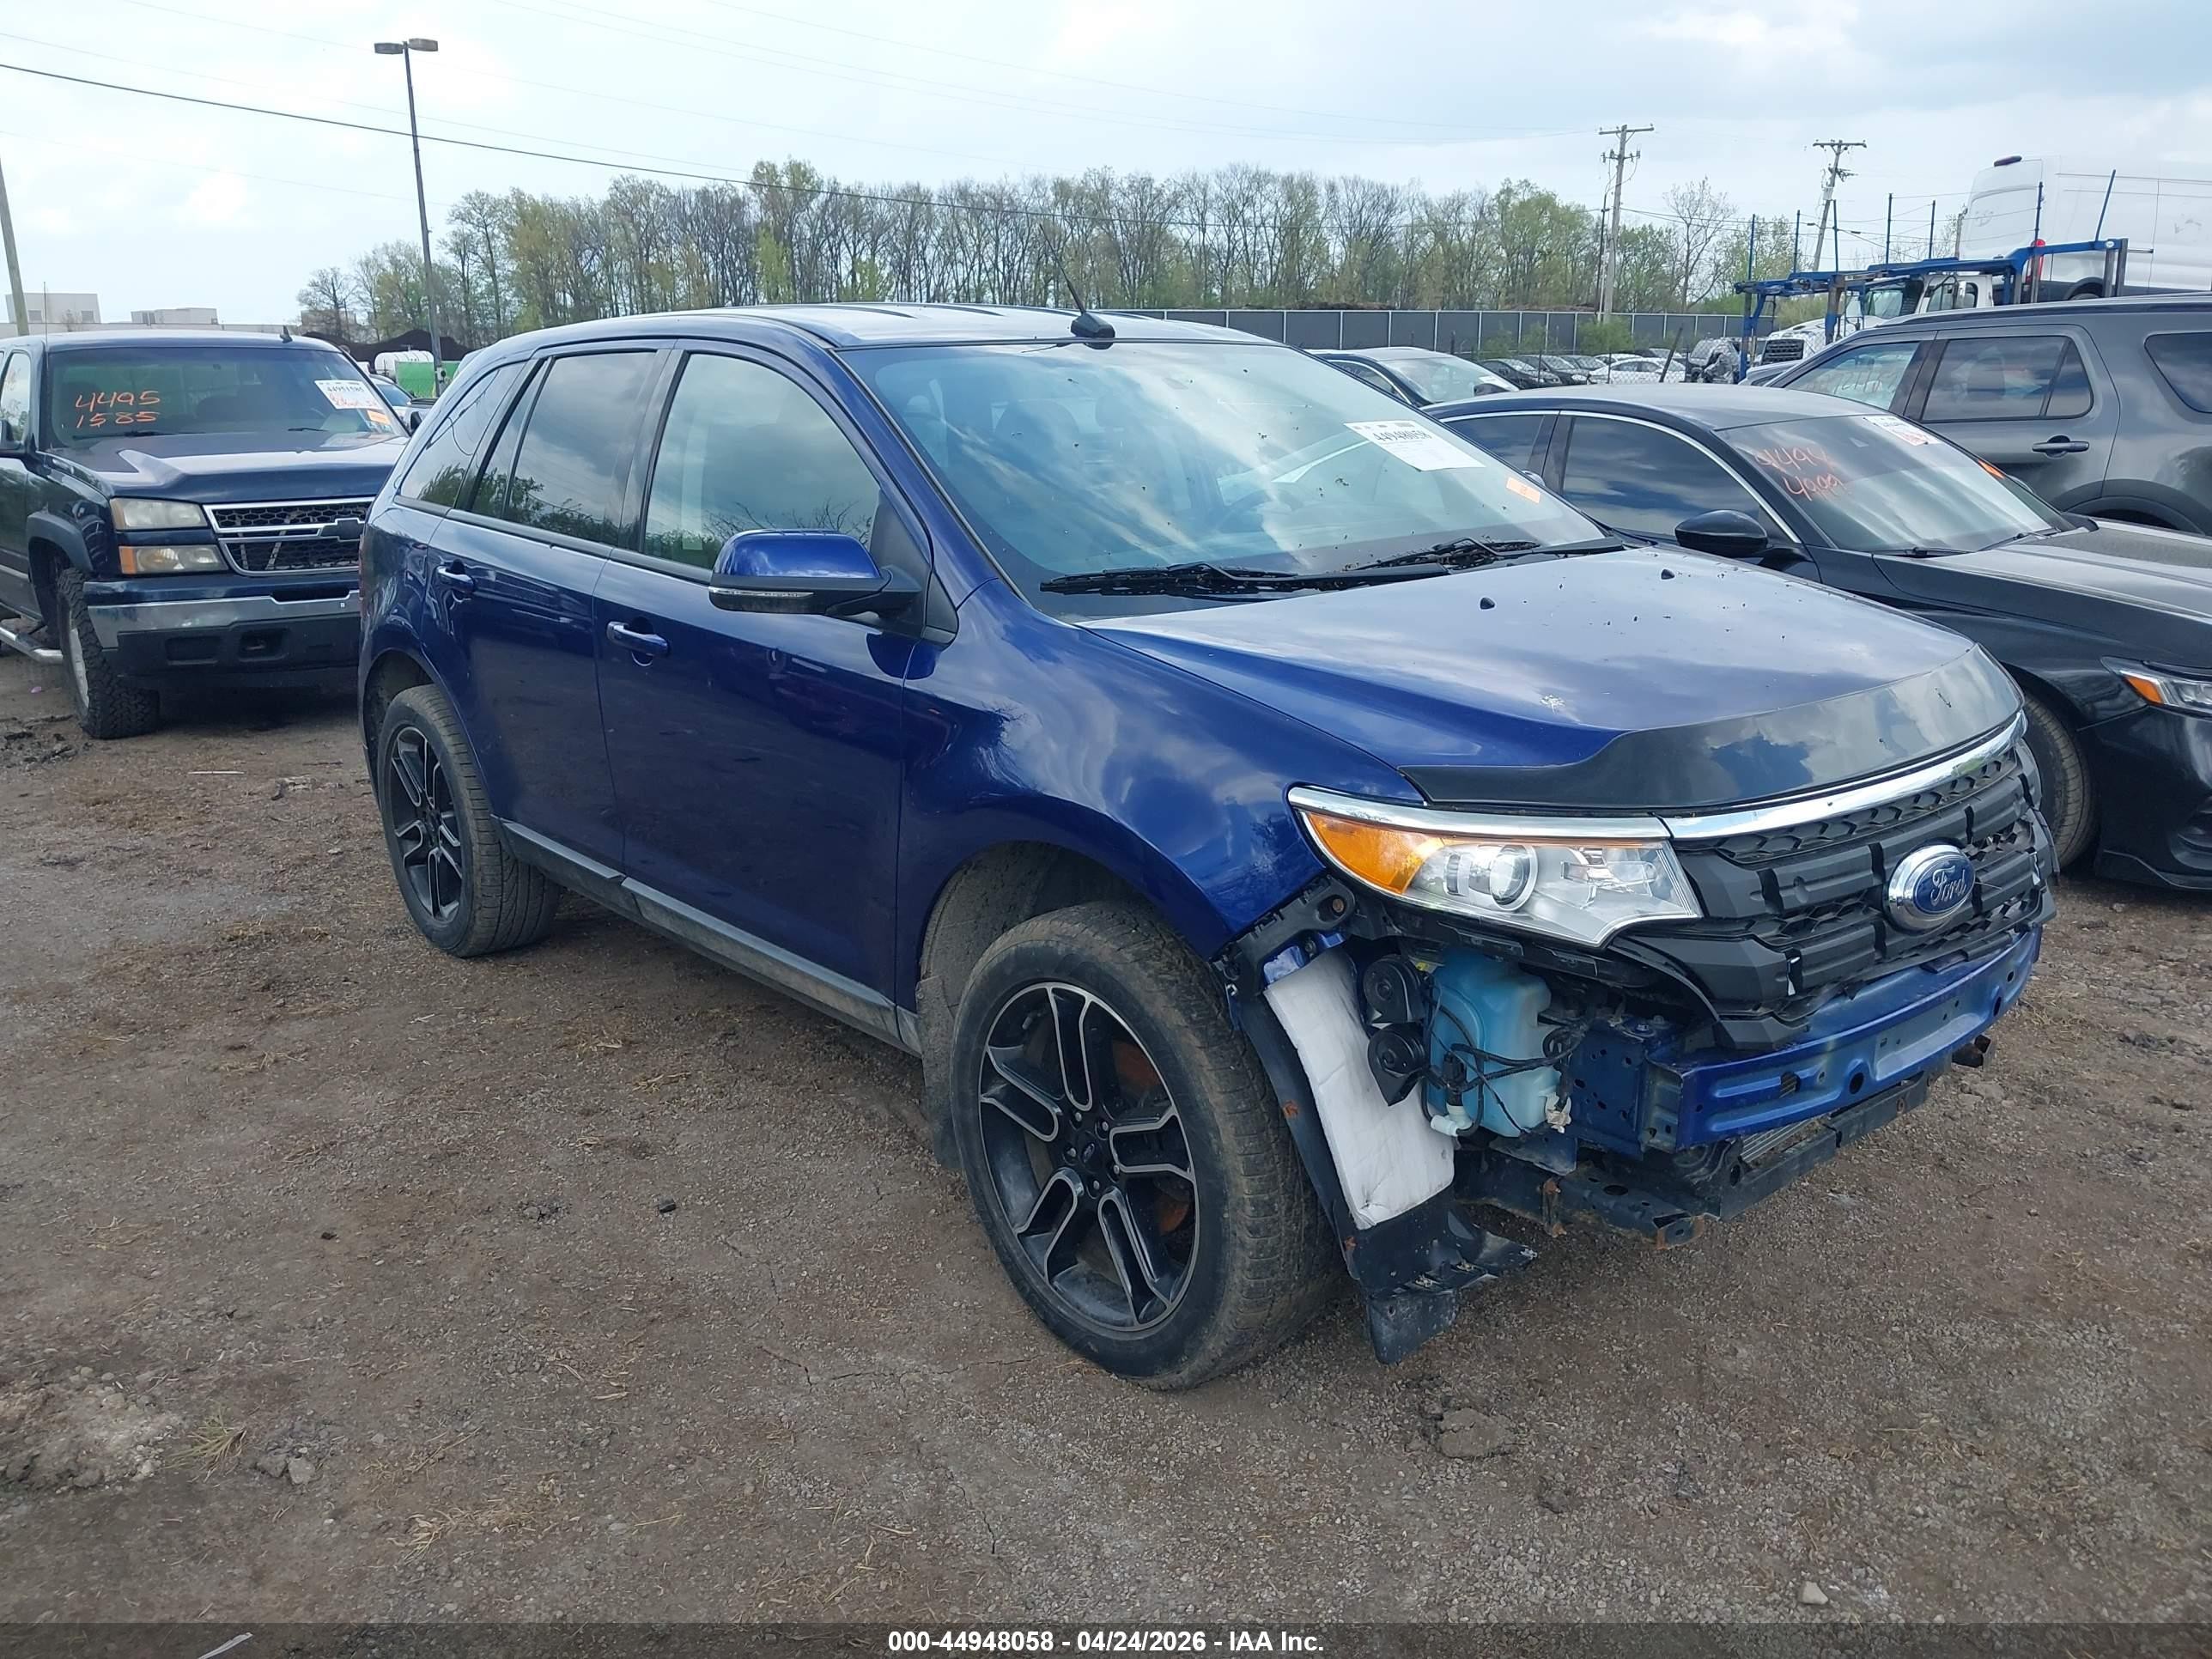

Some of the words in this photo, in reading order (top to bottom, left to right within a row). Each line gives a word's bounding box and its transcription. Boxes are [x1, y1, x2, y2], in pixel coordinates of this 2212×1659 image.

[75, 390, 161, 412] 4495
[76, 411, 161, 428] 1585
[1929, 865, 1967, 908] Ford
